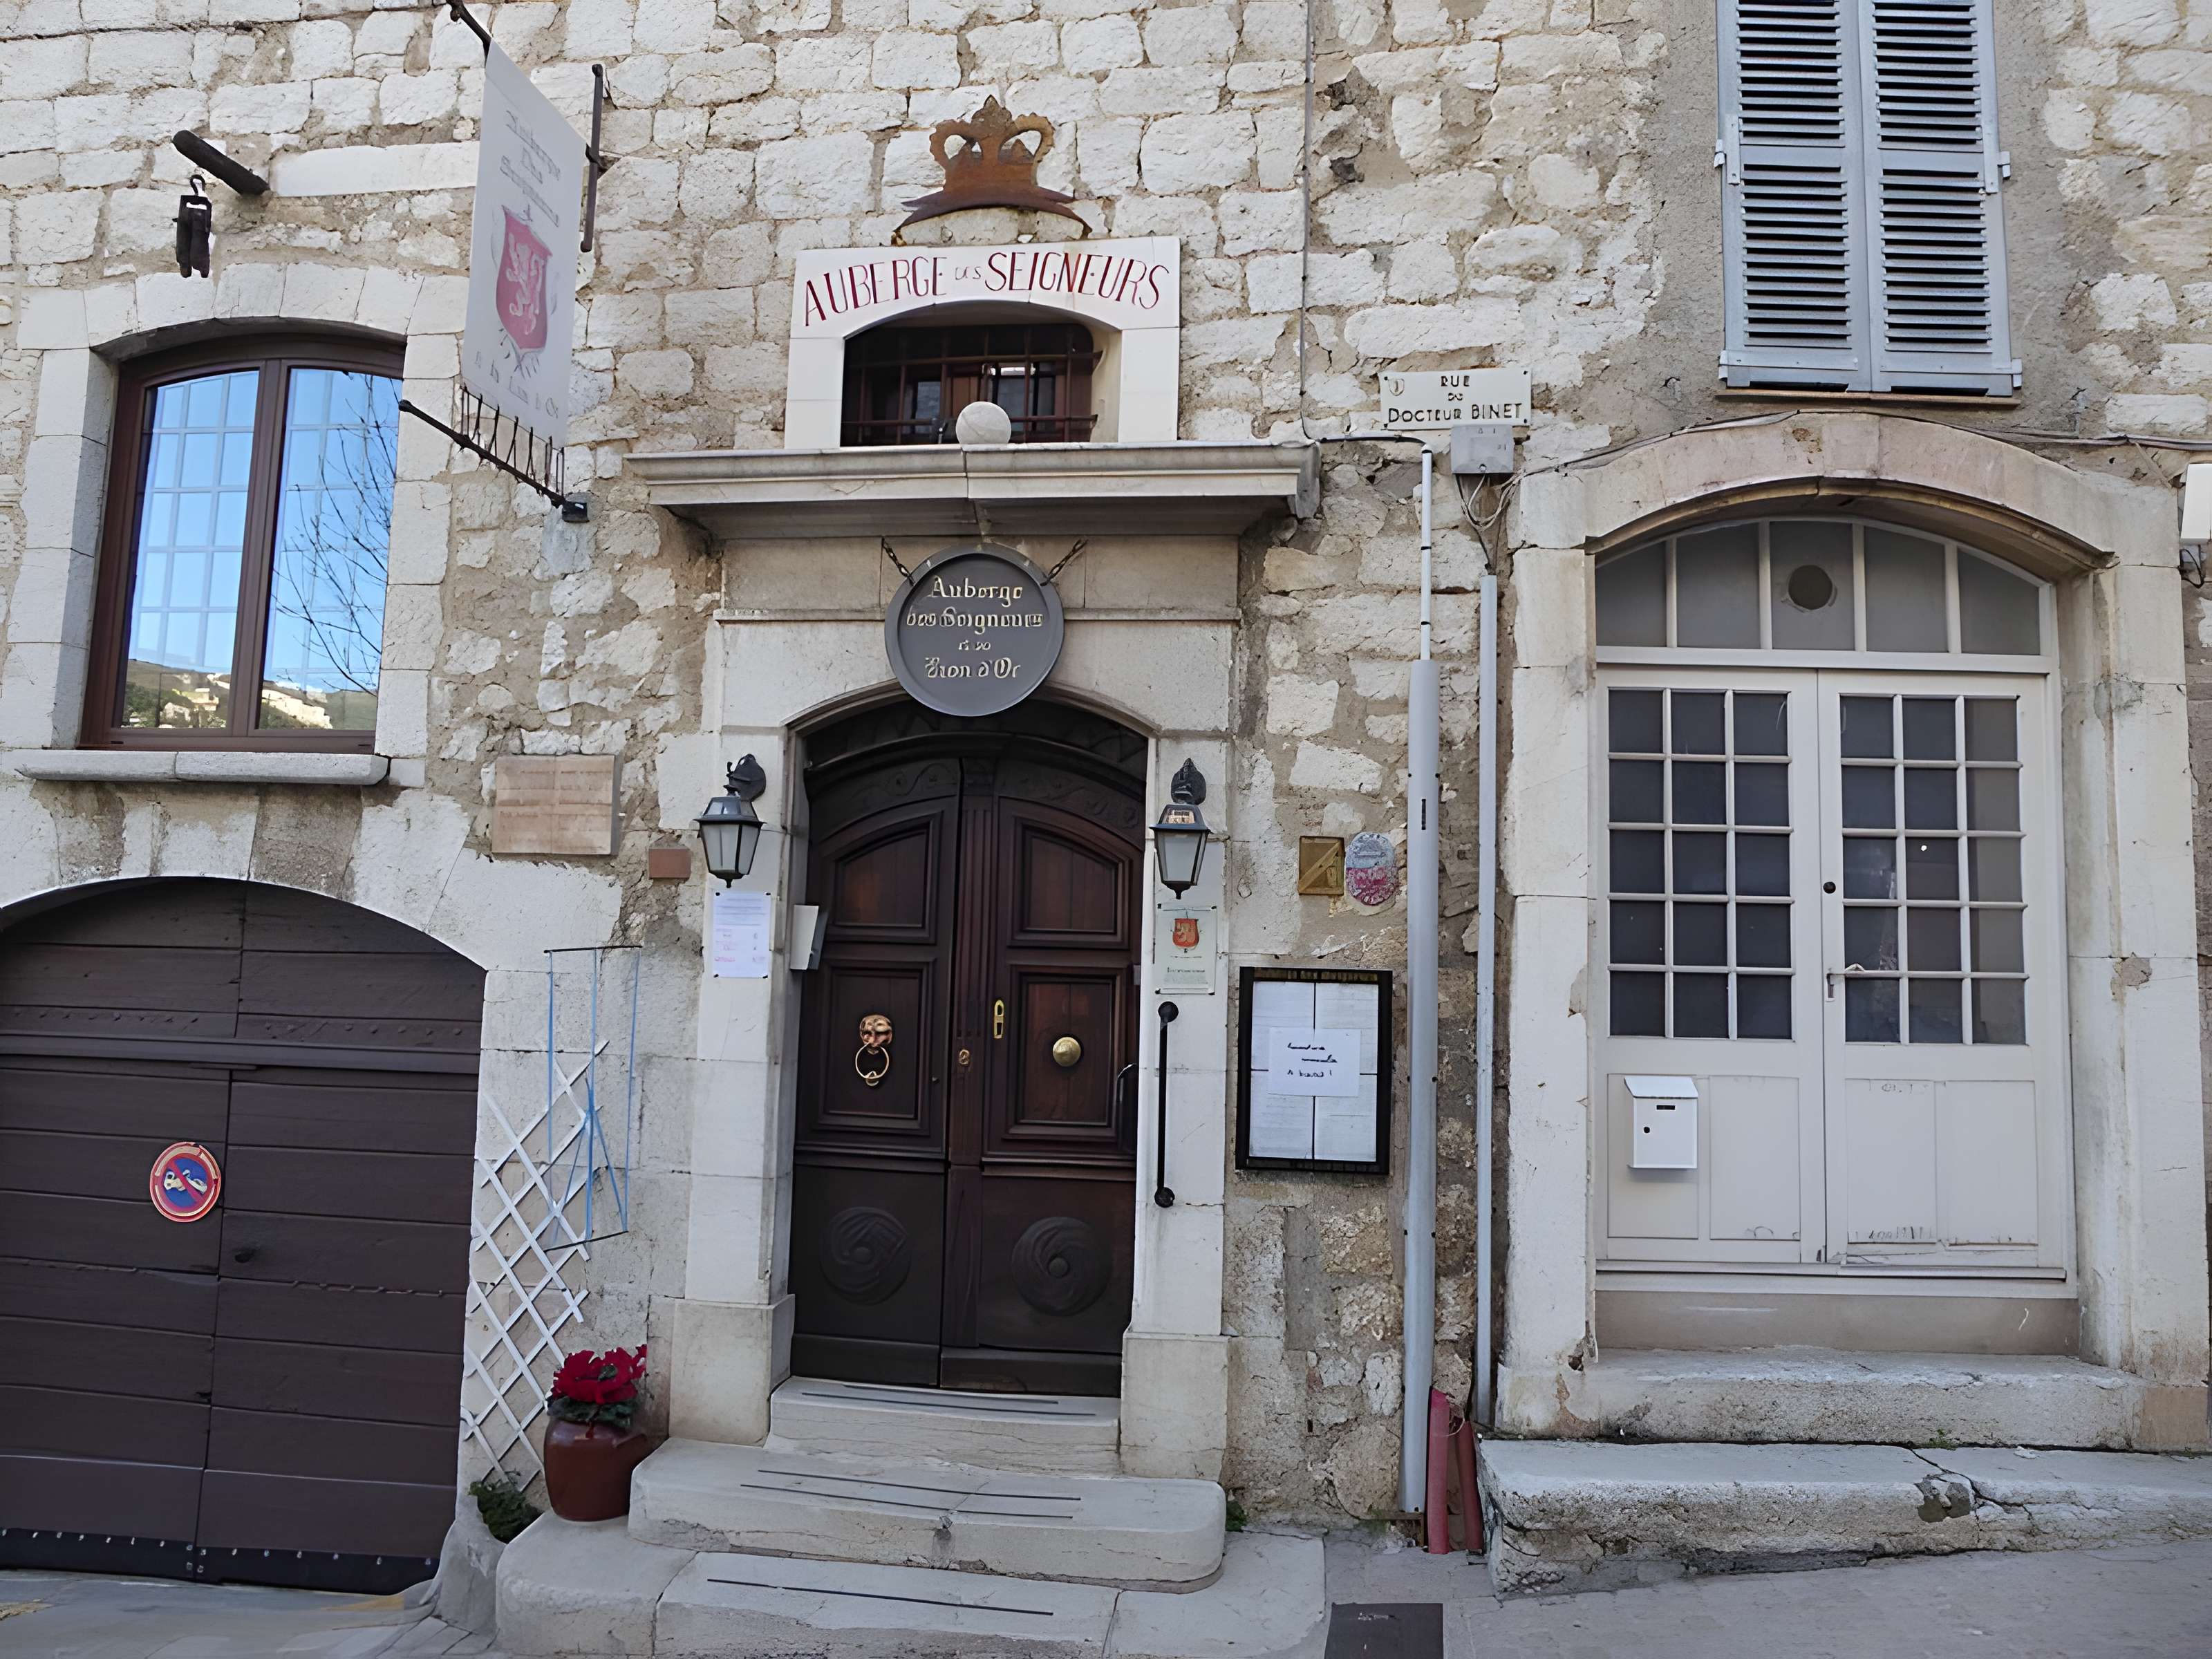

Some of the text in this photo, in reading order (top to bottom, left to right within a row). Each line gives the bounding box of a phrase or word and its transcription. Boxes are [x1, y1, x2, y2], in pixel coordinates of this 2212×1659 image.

[805, 256, 948, 327] AUBERGE
[984, 252, 1170, 310] SEIGNEURS
[1441, 375, 1470, 387] RUE
[1388, 403, 1522, 422] DOCTEUR BINET
